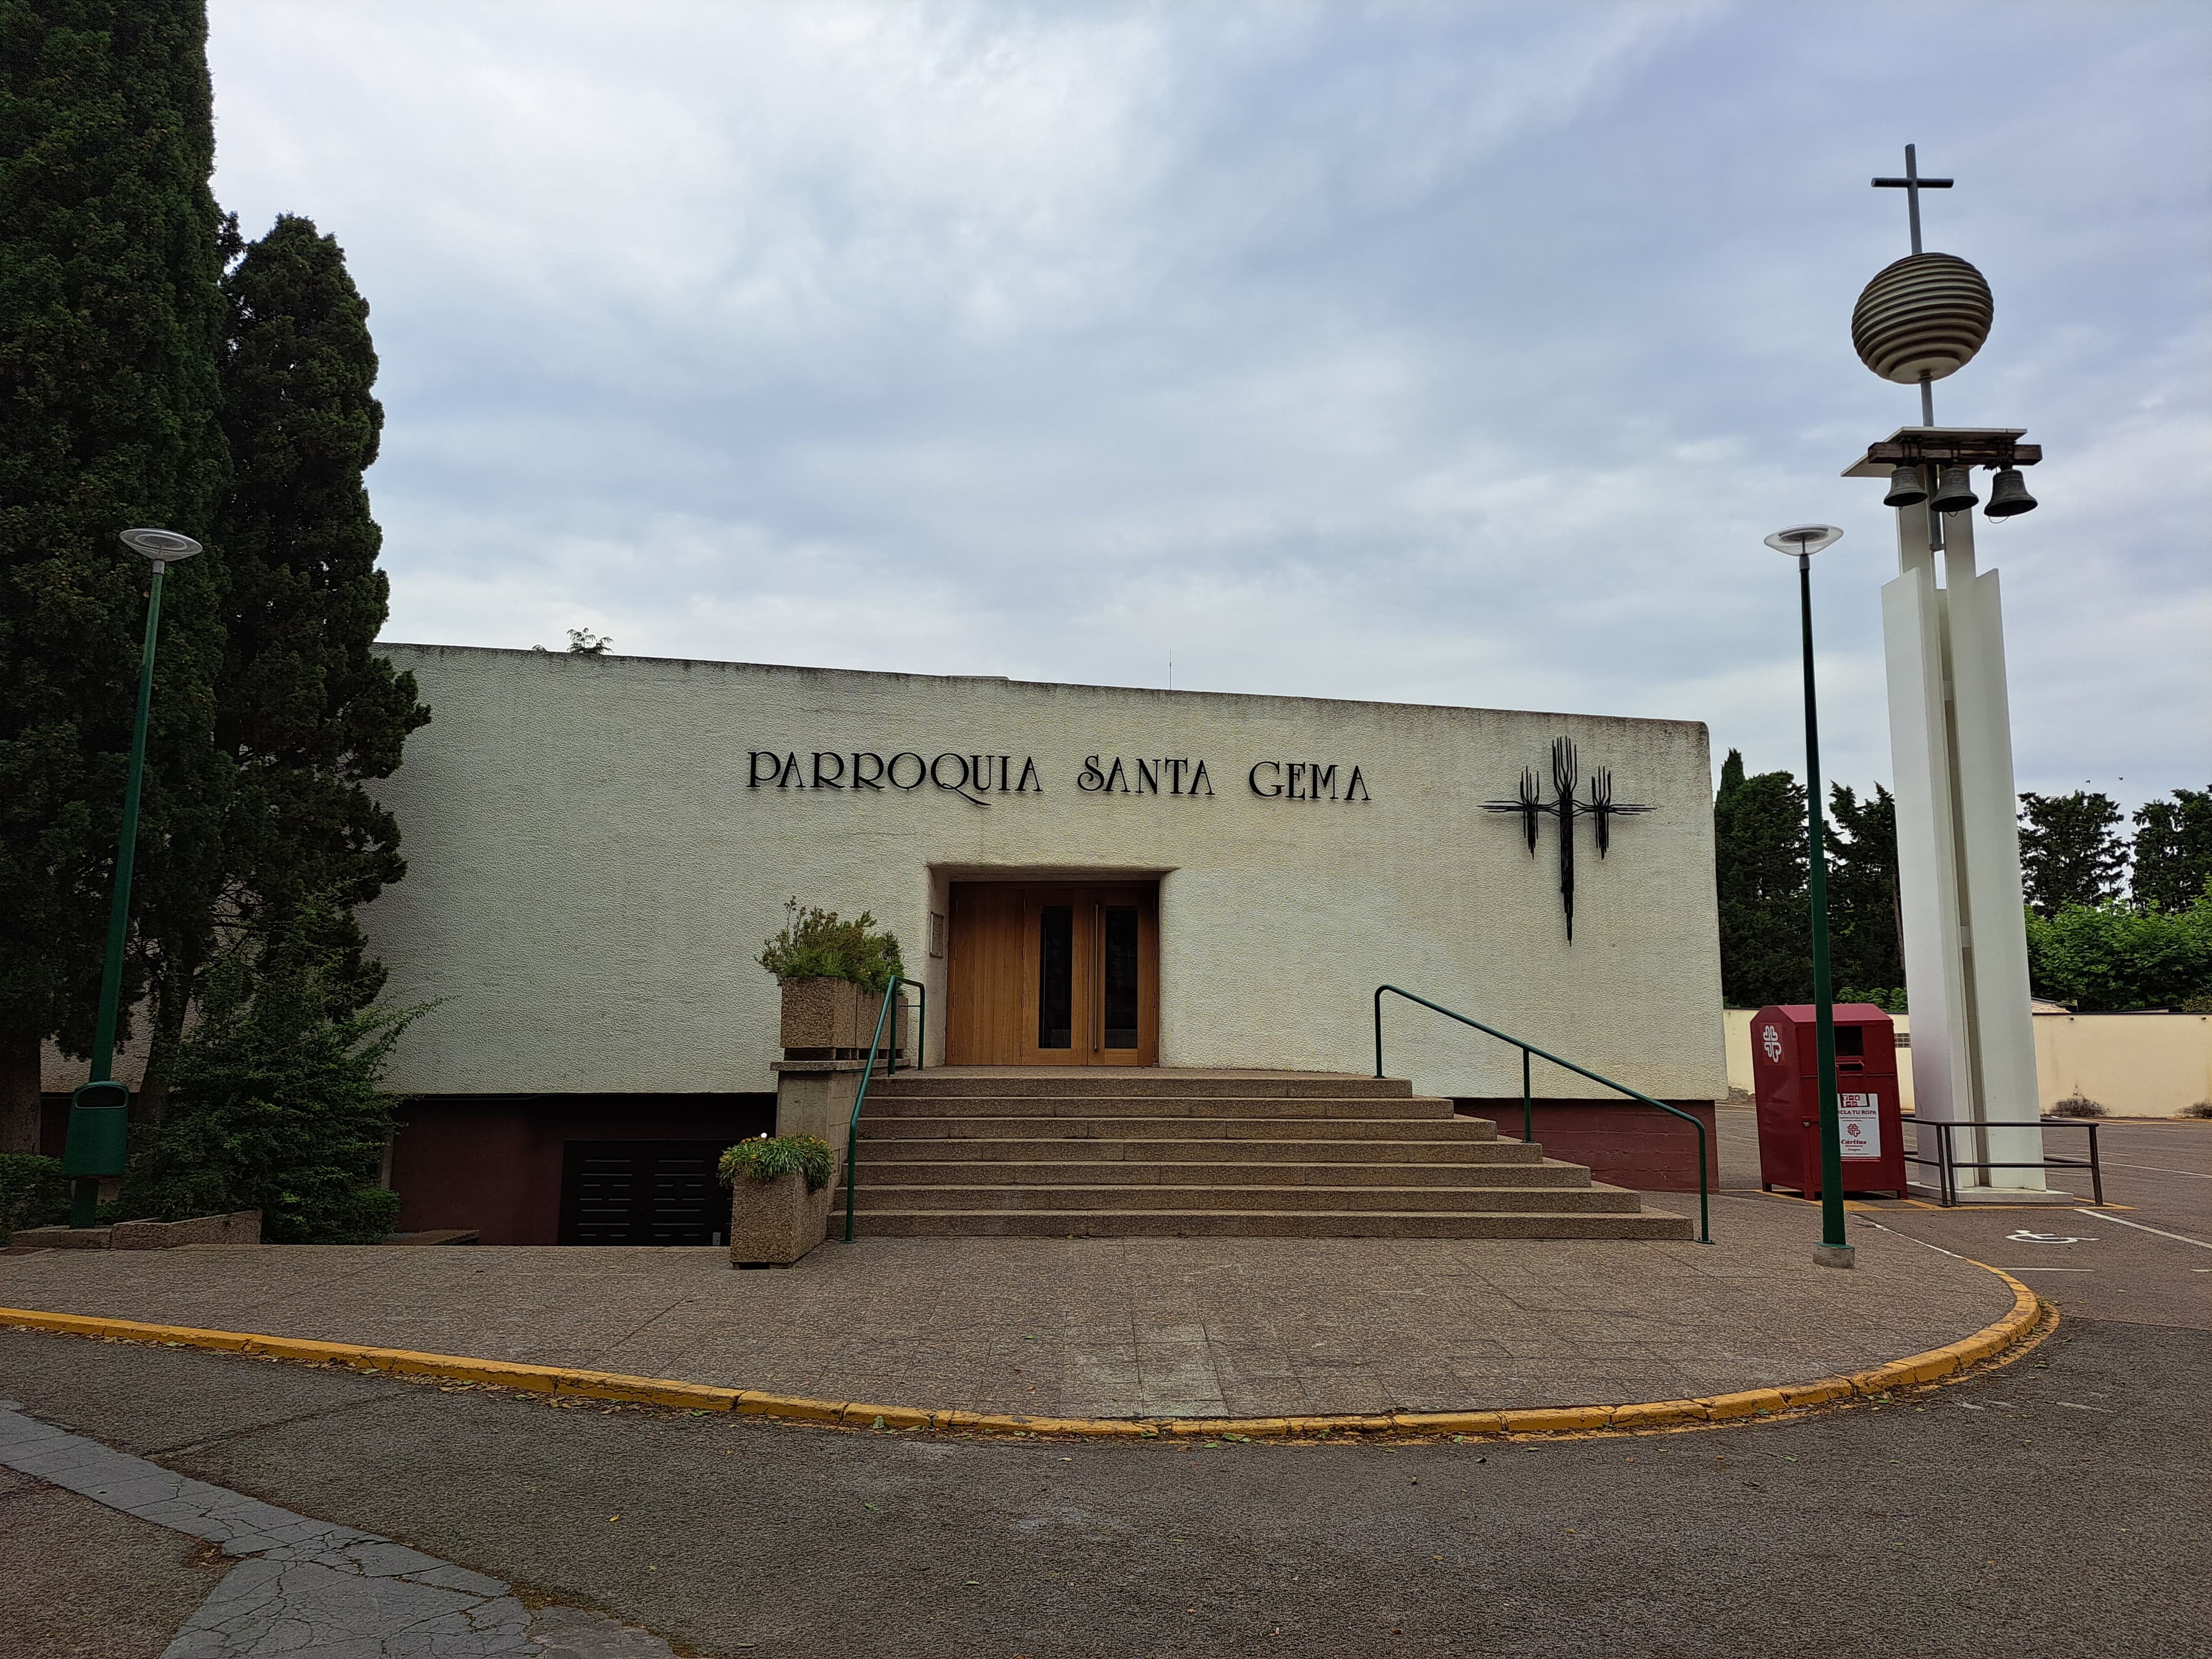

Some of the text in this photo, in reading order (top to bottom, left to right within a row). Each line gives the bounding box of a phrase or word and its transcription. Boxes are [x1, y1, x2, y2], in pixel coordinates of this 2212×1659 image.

[746, 751, 1372, 806] PARROQUIA SANTA GEMA
